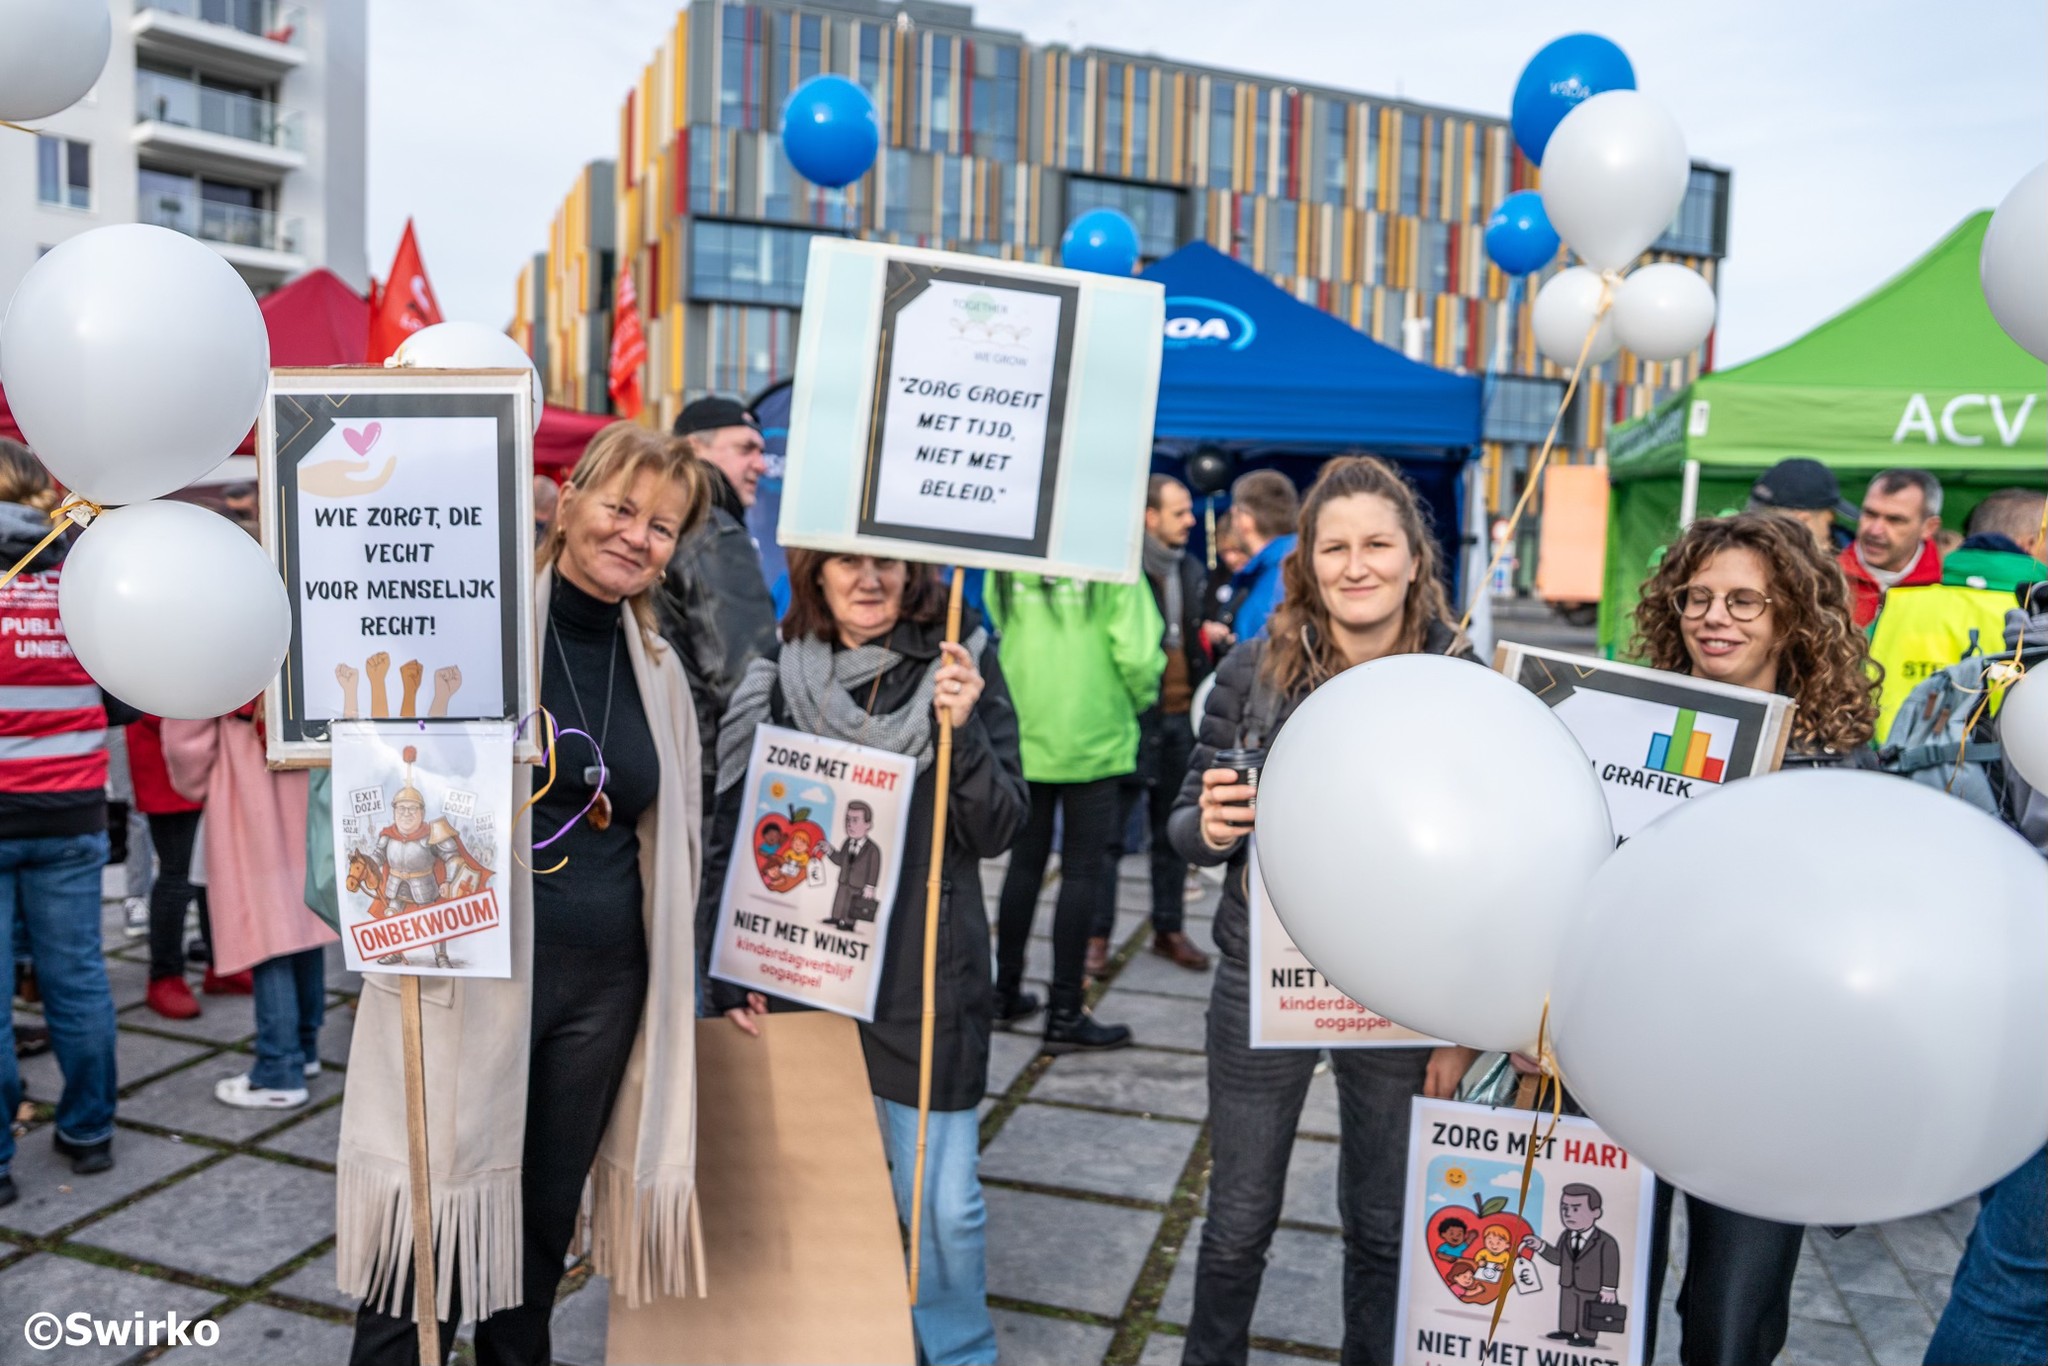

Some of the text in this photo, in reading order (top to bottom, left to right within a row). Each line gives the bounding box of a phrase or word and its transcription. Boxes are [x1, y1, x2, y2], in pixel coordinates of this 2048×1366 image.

[973, 351, 1028, 367] WE GROW
[967, 385, 1043, 409] GROEIT
[917, 412, 961, 431] MET
[1892, 393, 2037, 447] ACV
[915, 446, 1011, 471] NIET MET
[314, 506, 482, 529] WIE ZORGT, DIE
[364, 543, 435, 563] VECHT
[305, 579, 495, 600] VOOR MENSELIJK
[2, 617, 65, 635] PUBLI
[360, 616, 436, 636] RECHT!
[767, 745, 899, 791] ZORG MET HART
[355, 790, 378, 802] EXIT
[355, 800, 381, 814] DOZJE
[449, 791, 472, 804] EXIT
[444, 801, 472, 816] DOZJE
[360, 897, 494, 951] ONBEKWOUM
[733, 909, 870, 961] NIET MET WINST
[736, 936, 854, 981] kinderdagverblijf
[760, 963, 822, 988] oogappel
[1271, 968, 1317, 987] NIET
[1432, 1122, 1629, 1170] ZORG MET HART
[1417, 1329, 1471, 1358] NIET
[1478, 1339, 1529, 1366] MET
